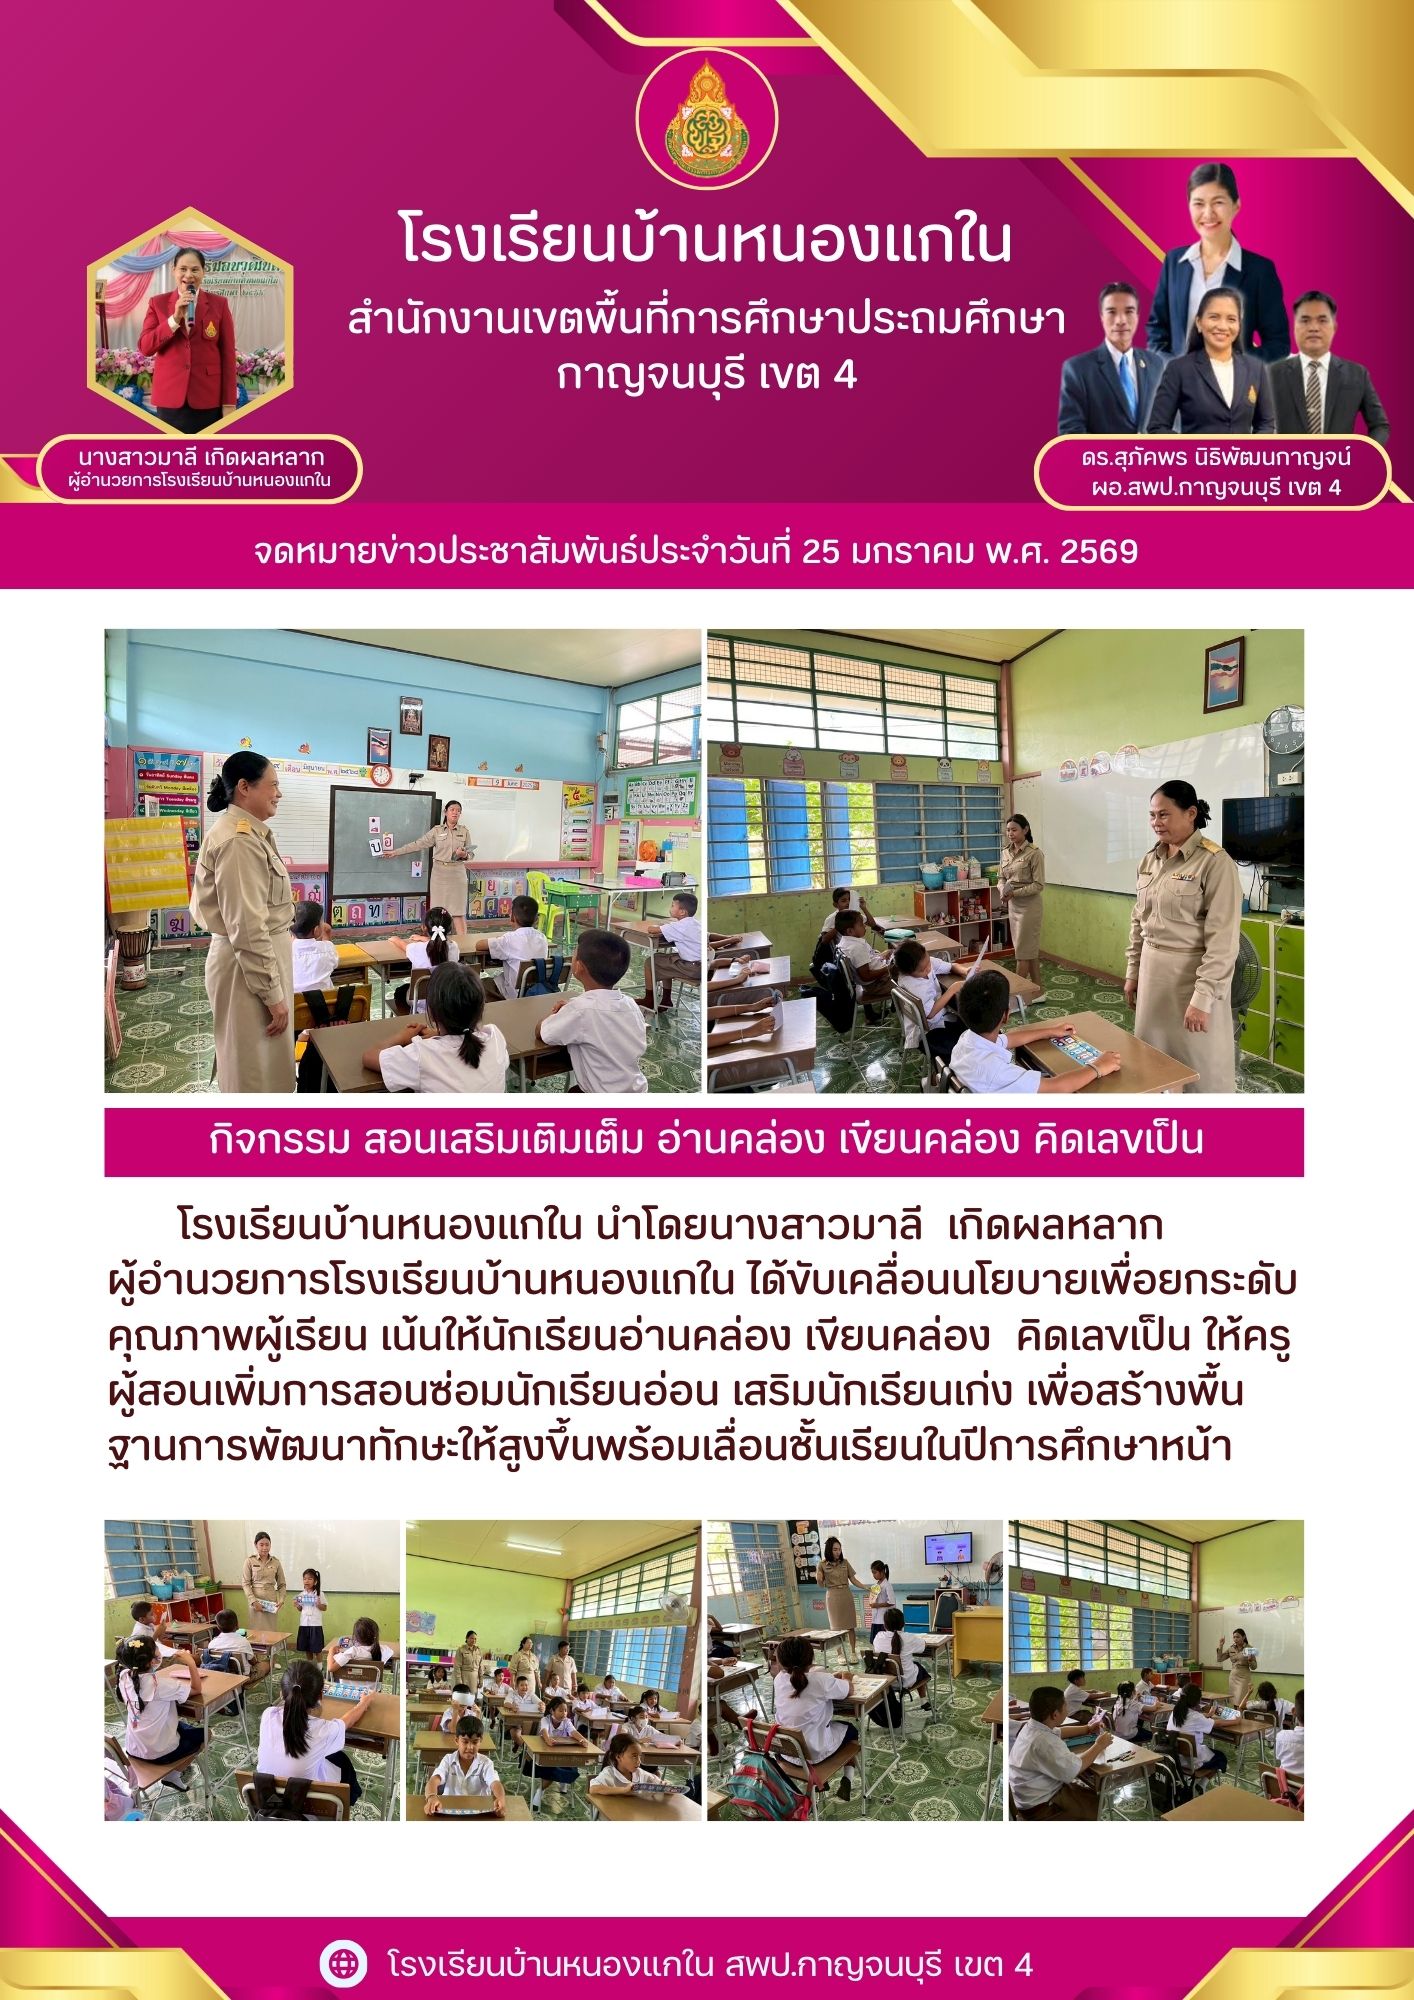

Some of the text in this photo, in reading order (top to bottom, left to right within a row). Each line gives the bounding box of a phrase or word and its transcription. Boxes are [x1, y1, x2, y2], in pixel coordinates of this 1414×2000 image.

[398, 209, 1010, 262] โรงเรียนบ้านหนองแกใน
[349, 289, 1064, 334] สำนักงานเขตพื้นที่การศึกษาประถมศึกษา
[558, 353, 857, 400] กาญจนบุรี เขต 4
[79, 446, 325, 466] นางสาวมาลี เกิดผลหลาก
[1082, 446, 1351, 471] ดร.สุภัคพร นิธิพัฒนกาญจน์
[68, 472, 331, 492] ผู้อำนวยการโรงเรียนบ้านหนองแกใน
[1092, 476, 1342, 502] ผอ.สพป.กาญจนบุรี เขต 4
[255, 527, 1137, 563] จดหมายข่าวประชาสัมพันธ์ประจำวันที่ 25 มกราคม พ.ศ. 2569
[209, 1117, 1203, 1154] กิจกรรม สอนเสริมเติมเต็ม อ่านคล่อง เขียนคล่อง คิดเลขเป็น
[177, 1204, 1162, 1240] โรงเรียนบ้านหนองแกใน นำโดยนางสาวมาลี เกิดผลหลาก
[110, 1251, 1296, 1306] ผู้อำนวยการโรงเรียนบ้านหนองแกใน ได้ขับเคลื่อนนโยบายเพื่อยกระดับ
[109, 1314, 1291, 1362] คุณภาพผู้เรียน เน้นให้นักเรียนอ่านคล่อง เขียนคล่อง คิดเลขเป็น ให้ครู
[109, 1362, 1243, 1417] ผู้สอนเพิ่มการสอนซ่อมนักเรียนอ่อน เสริมนักเรียนเก่ง เพื่อสร้างพื้น
[108, 1418, 1231, 1472] ฐานการพัฒนาทักษะให้สูงขึ้นพร้อมเลื่อนชั้นเรียนในปีการศึกษาหน้า
[387, 1947, 1034, 1985] โรงเรียนบ้านหนองแกใน สพป.กาญจนบุรี เขต 4
